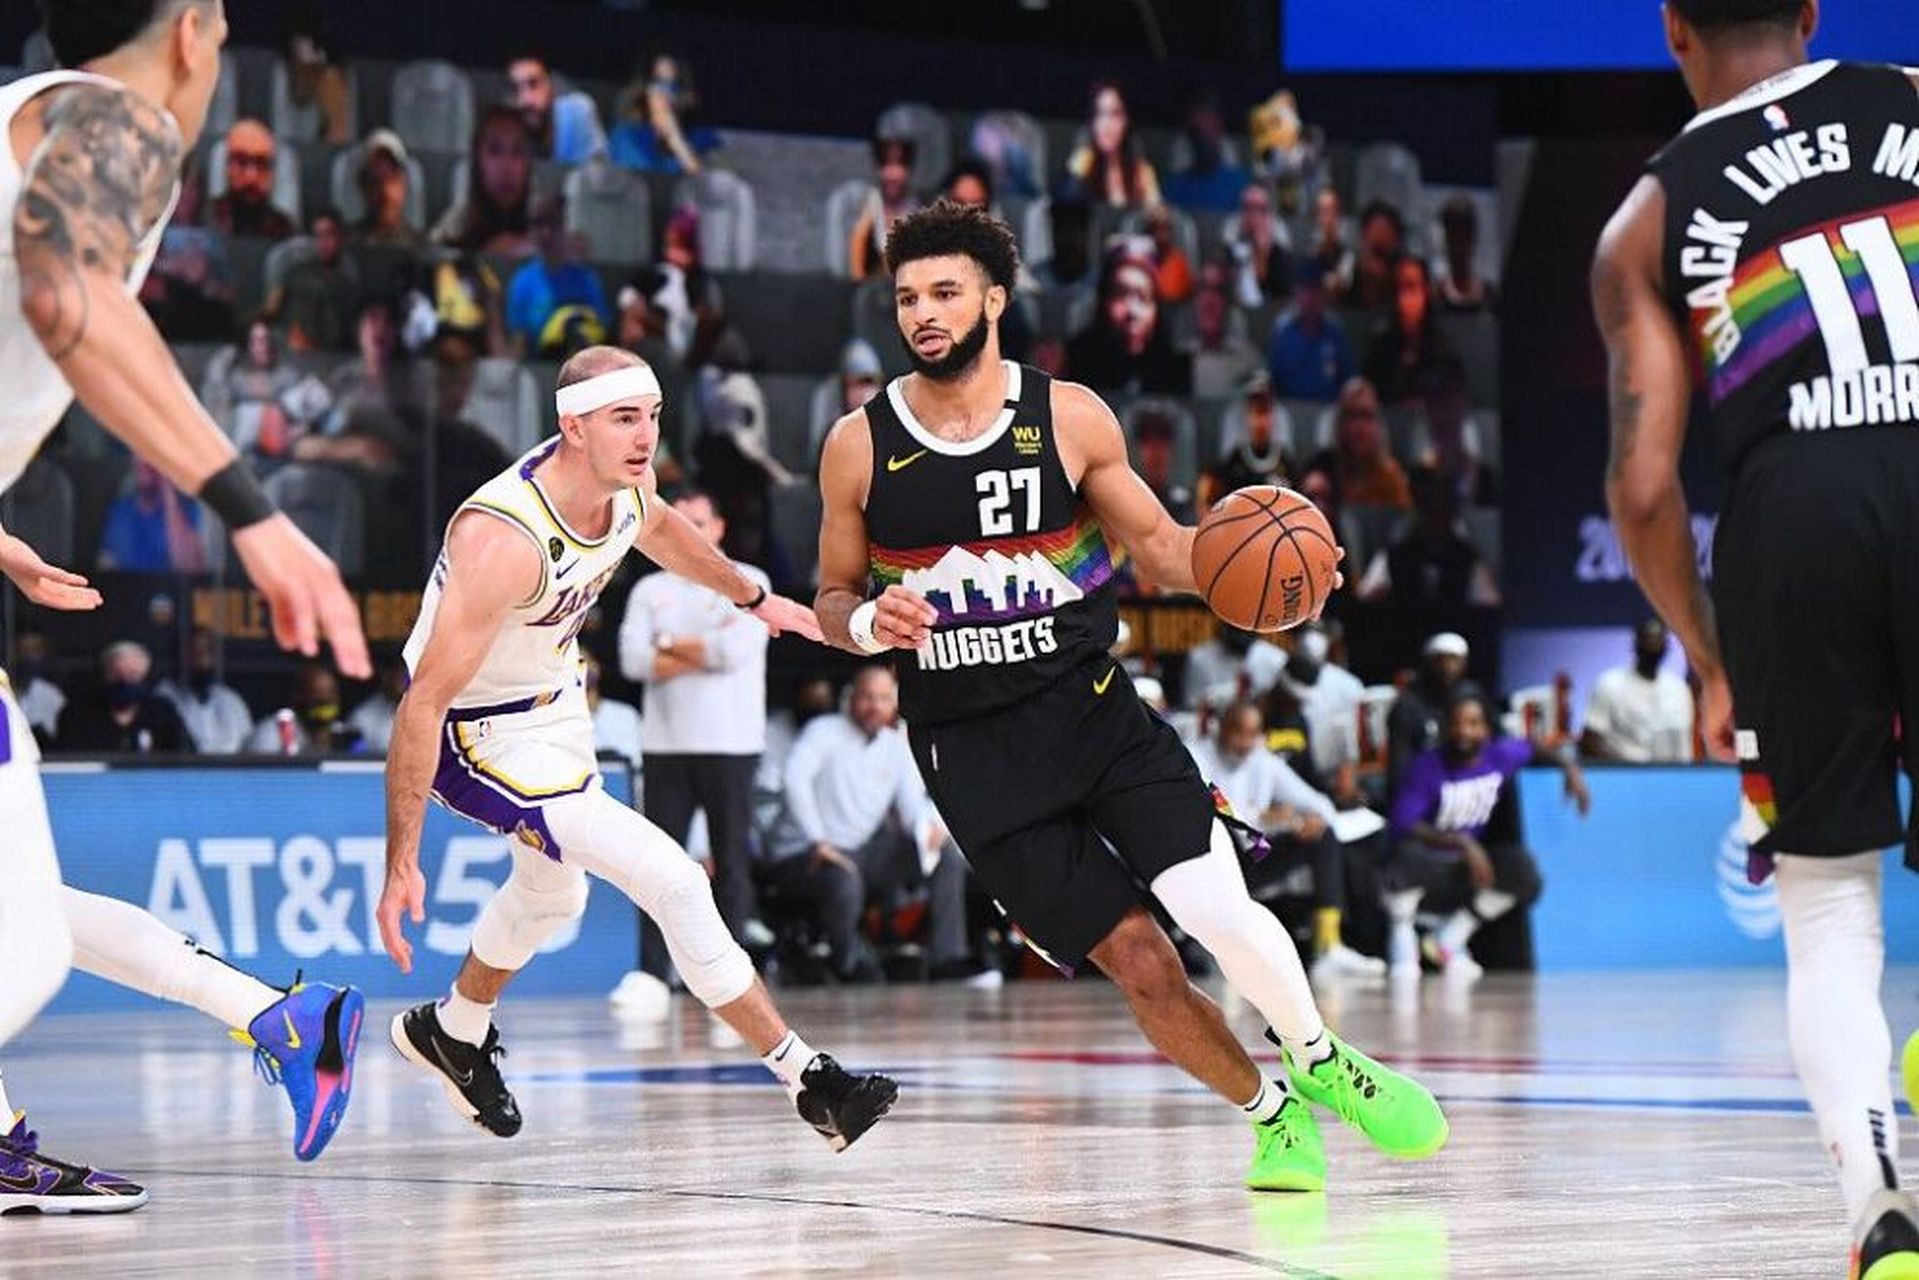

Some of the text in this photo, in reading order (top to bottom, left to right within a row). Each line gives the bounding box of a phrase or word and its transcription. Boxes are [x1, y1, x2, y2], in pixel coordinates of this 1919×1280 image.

[1680, 122, 1919, 365] BLACK LIVES M
[1778, 215, 1919, 378] 11
[1011, 425, 1041, 441] WU
[975, 466, 1041, 536] 27
[1280, 576, 1303, 623] DING
[916, 615, 1058, 671] NUGGETS
[147, 835, 389, 957] AT&T
